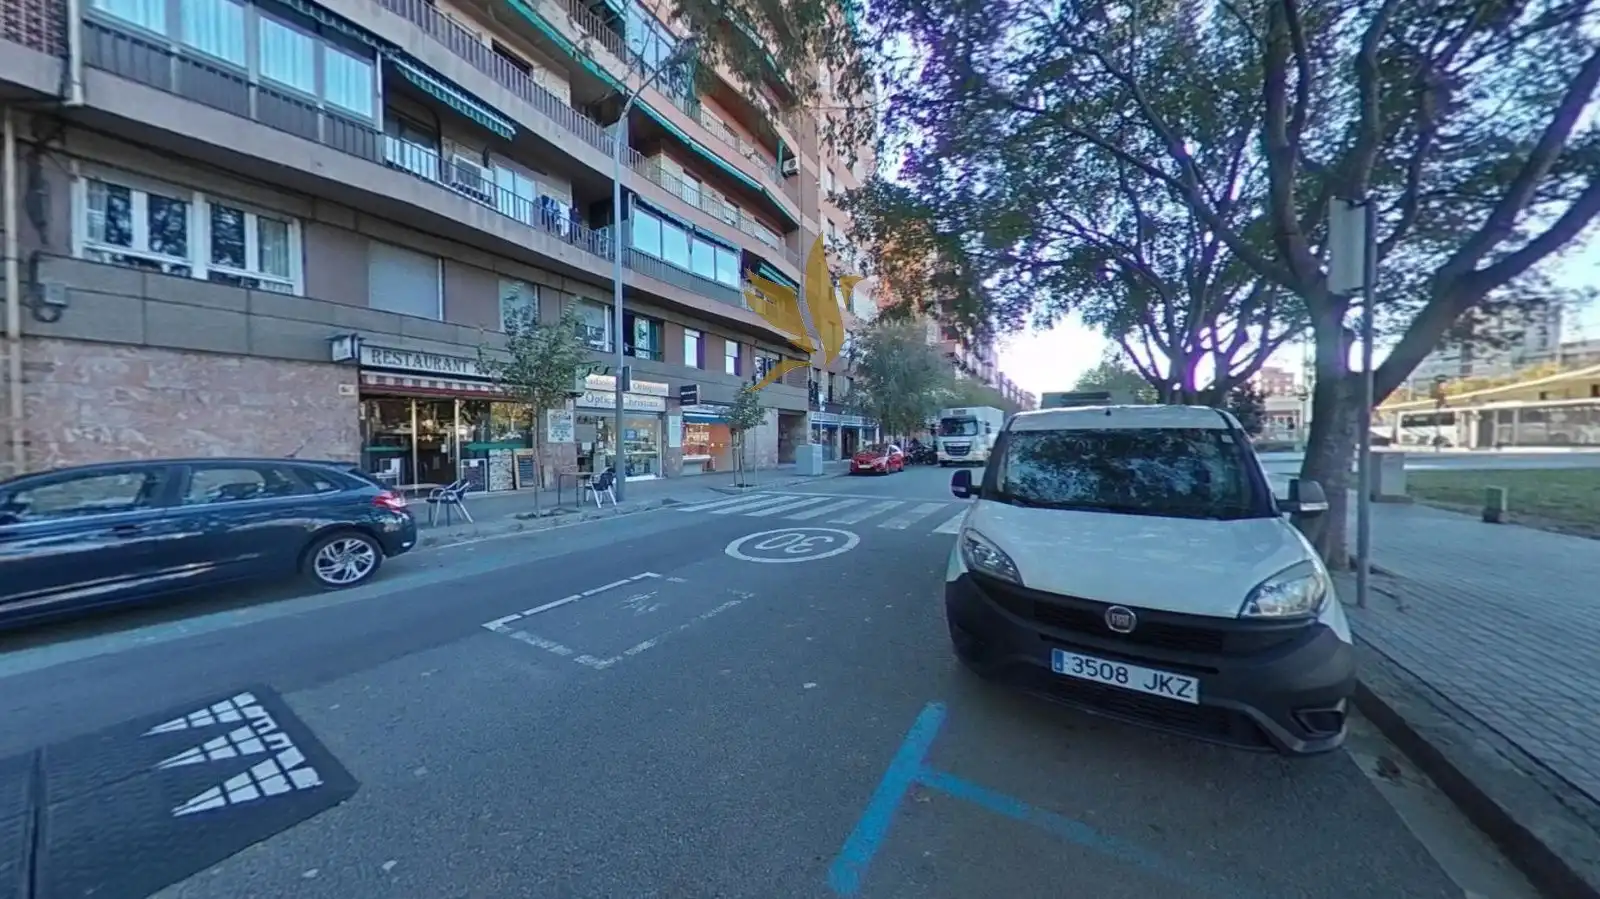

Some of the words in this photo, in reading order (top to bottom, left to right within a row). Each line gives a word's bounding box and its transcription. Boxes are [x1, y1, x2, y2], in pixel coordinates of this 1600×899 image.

[371, 349, 469, 373] RESTAURANT
[1072, 656, 1129, 684] 3508
[1143, 673, 1193, 699] JKZ
